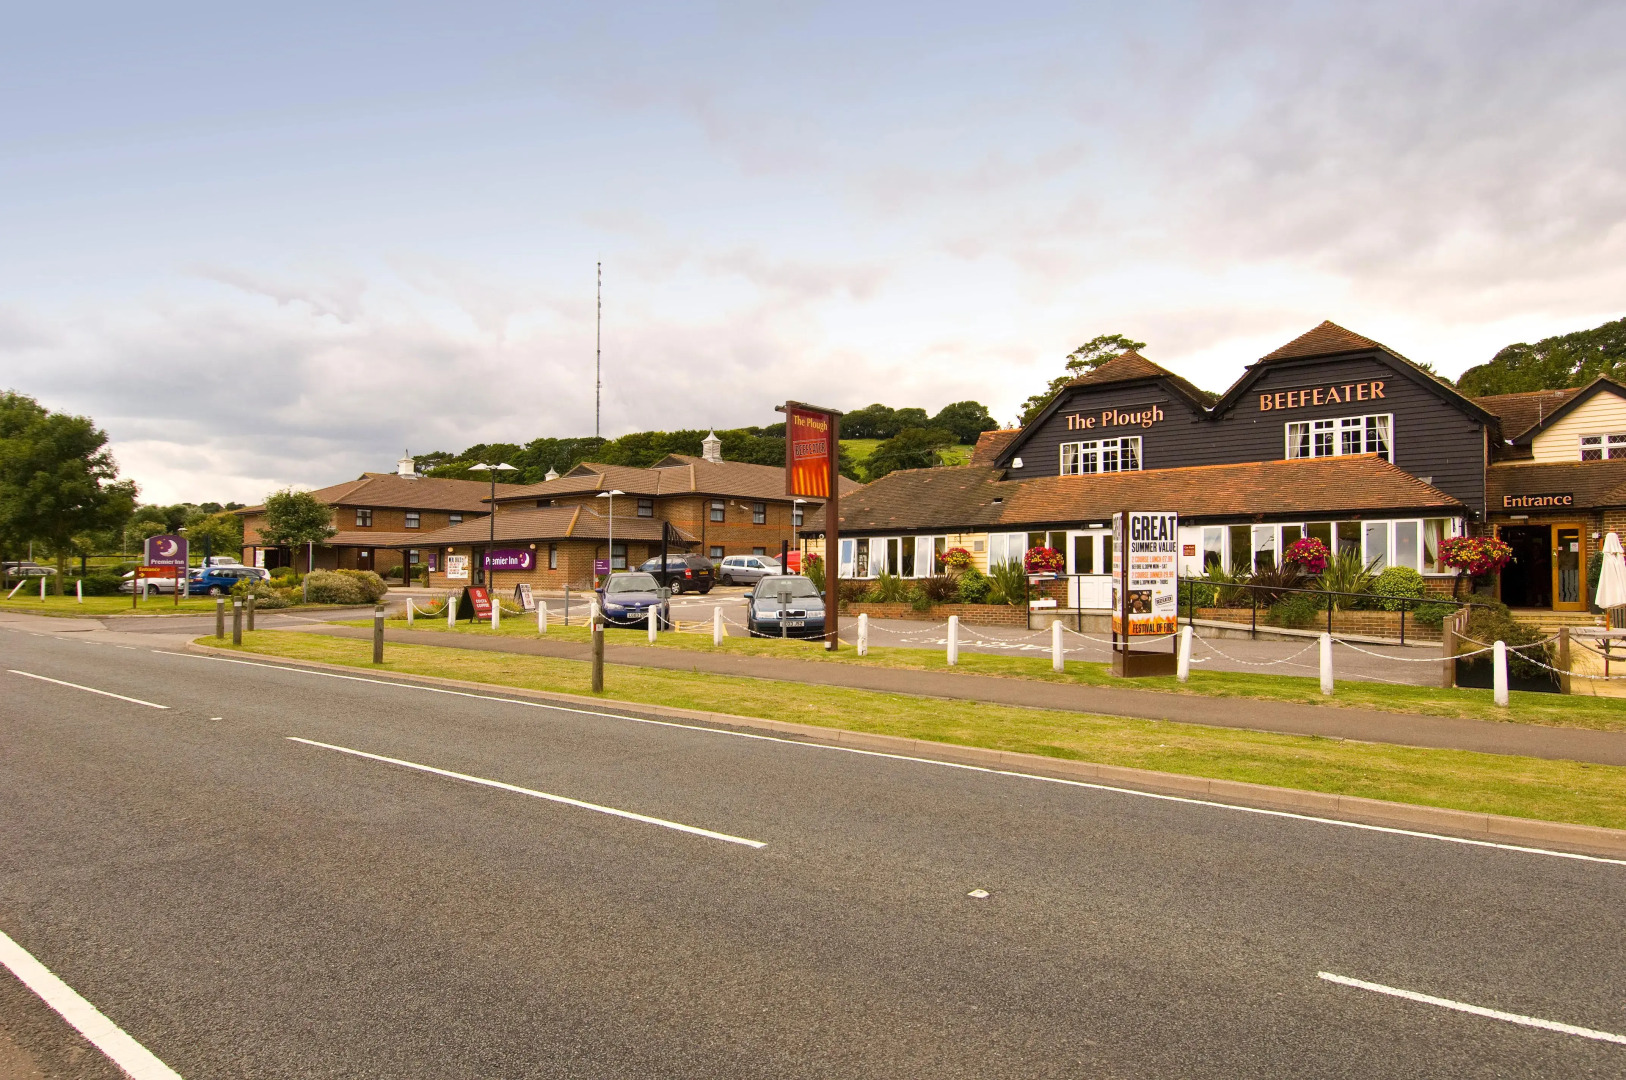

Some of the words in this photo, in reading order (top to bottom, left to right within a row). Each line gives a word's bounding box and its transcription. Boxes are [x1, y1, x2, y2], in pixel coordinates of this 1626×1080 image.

[1260, 381, 1385, 411] BEEFEATER
[794, 415, 805, 426] The
[807, 418, 827, 432] Plough
[1065, 413, 1096, 430] The
[1102, 405, 1164, 428] Plough
[795, 442, 825, 456] BEEFEATER
[1503, 495, 1573, 508] Entrance
[1131, 516, 1176, 540] GREAT
[1131, 541, 1157, 552] SUMMER
[1159, 541, 1176, 552] VALUE
[509, 556, 518, 565] Inn
[1132, 623, 1155, 633] FESTIVAL
[1157, 624, 1163, 632] OF
[1164, 622, 1175, 632] FIRE
